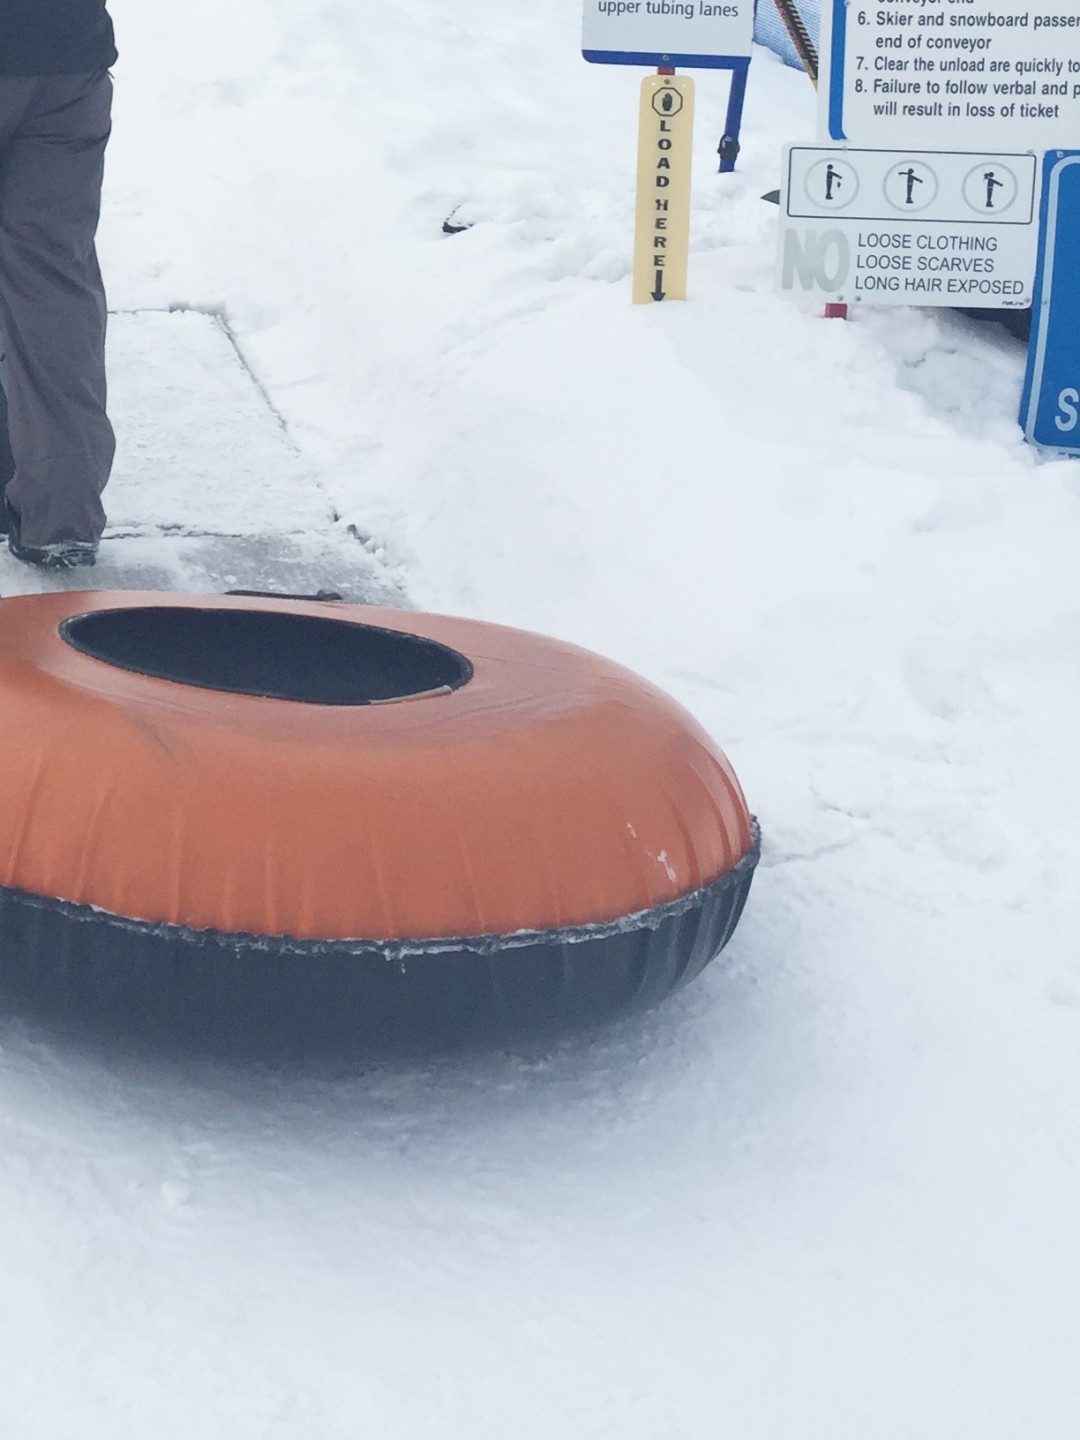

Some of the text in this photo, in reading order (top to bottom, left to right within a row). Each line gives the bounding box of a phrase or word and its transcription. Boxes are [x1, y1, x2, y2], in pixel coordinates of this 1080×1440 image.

[599, 0, 738, 19] upper tubing lanes
[858, 11, 1080, 30] 6. Skier and snowboard passer
[876, 34, 992, 53] end of conveyor
[856, 56, 1080, 76] 7. Clear the unload are quickly to
[855, 79, 867, 92] 8.
[874, 79, 921, 93] Failure
[927, 81, 940, 94] to
[946, 80, 987, 94] follow
[993, 81, 1036, 95] verbal
[1042, 81, 1068, 95] and
[874, 101, 1059, 118] will result in loss of ticket
[653, 120, 672, 266] LOAD HERE
[858, 233, 997, 251] LOOSE CLOTHING
[782, 228, 850, 293] NO
[857, 255, 994, 272] LOOSE SCARVES
[856, 276, 1023, 294] LONG HAIR EXPOSED
